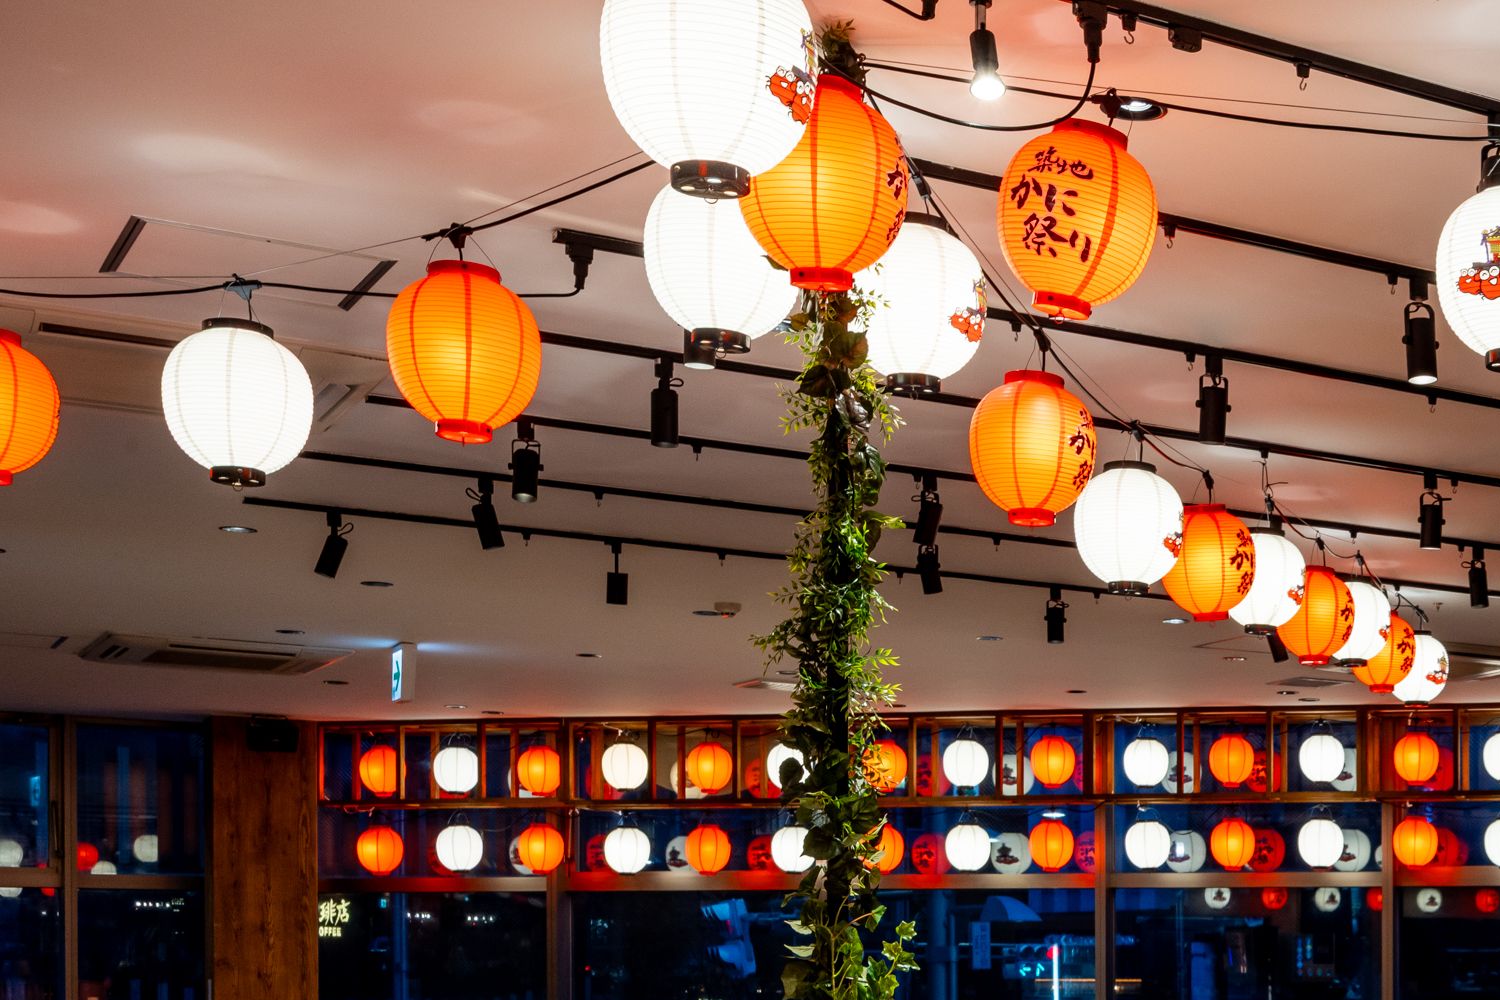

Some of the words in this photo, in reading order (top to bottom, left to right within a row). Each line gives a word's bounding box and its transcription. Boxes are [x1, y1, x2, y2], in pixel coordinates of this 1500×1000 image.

[1028, 146, 1094, 180] 築地
[1011, 174, 1078, 216] かに
[1022, 213, 1092, 263] 祭り
